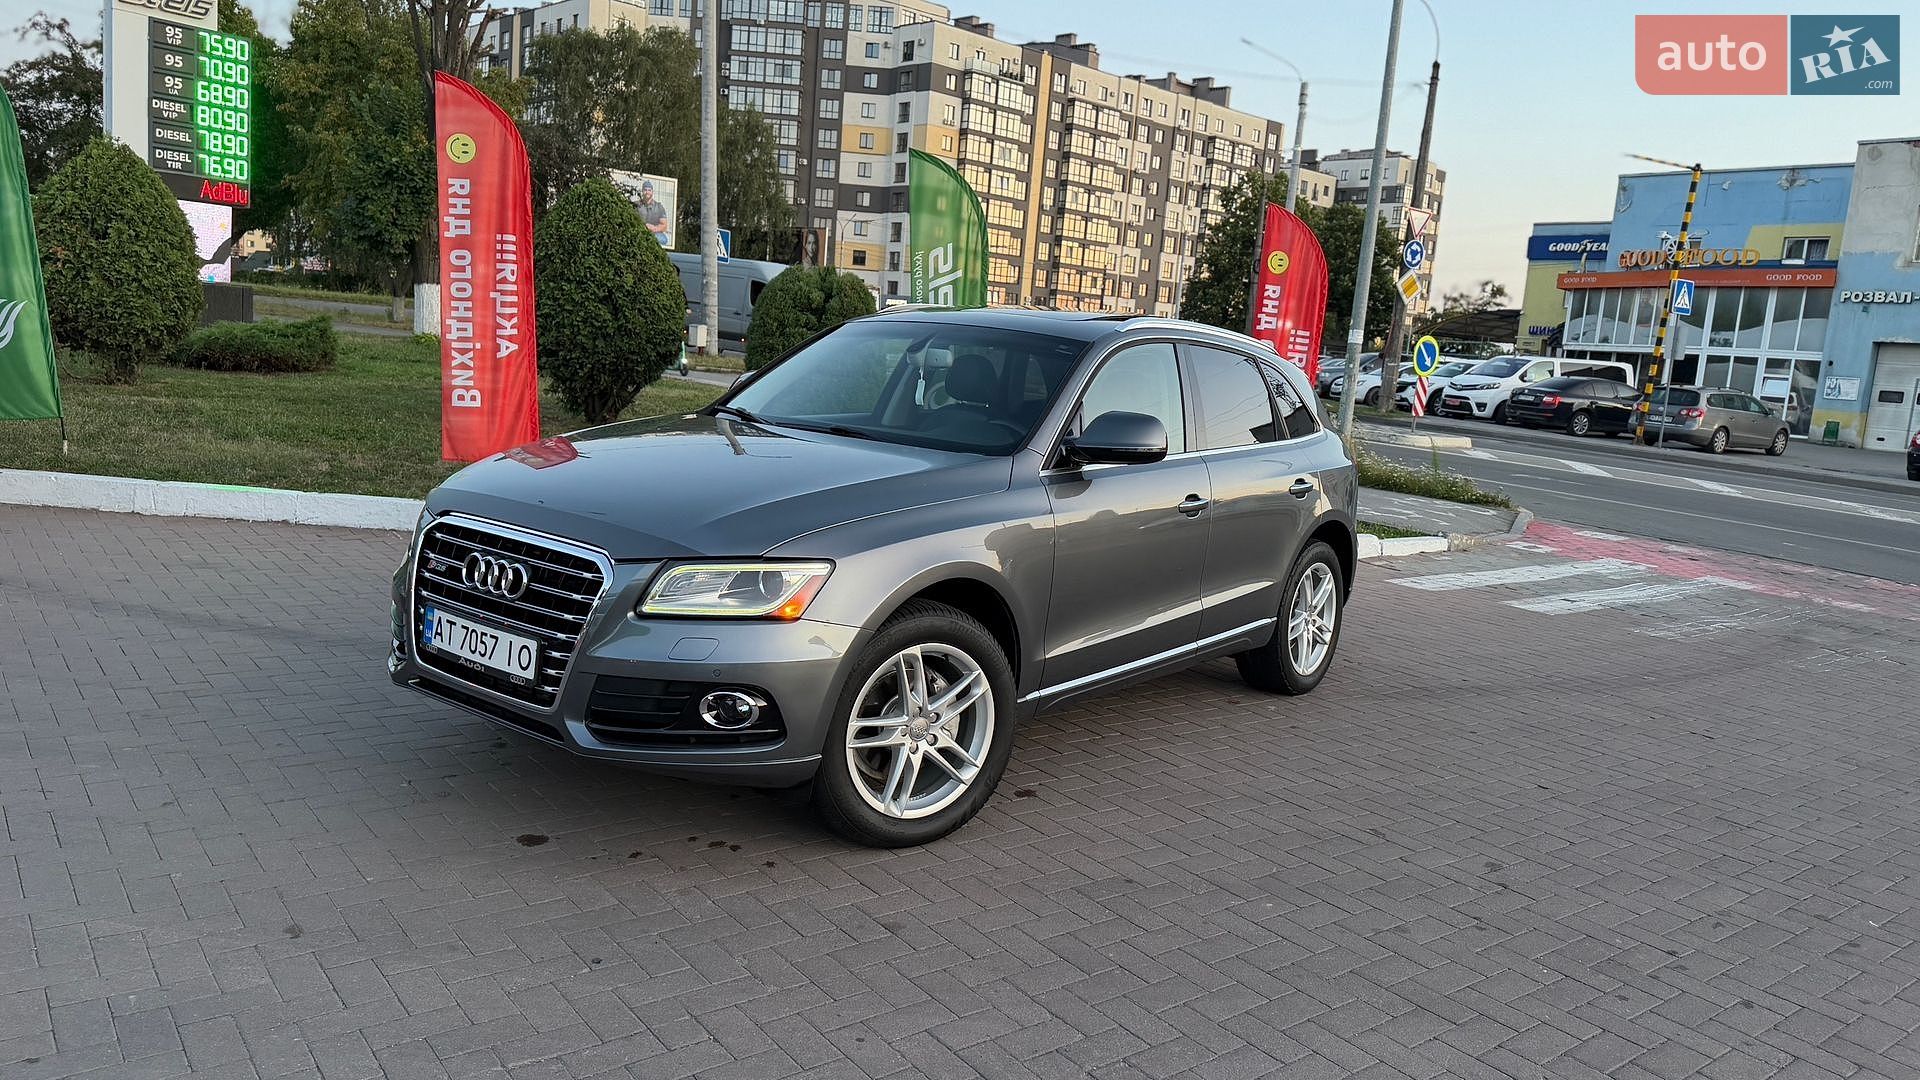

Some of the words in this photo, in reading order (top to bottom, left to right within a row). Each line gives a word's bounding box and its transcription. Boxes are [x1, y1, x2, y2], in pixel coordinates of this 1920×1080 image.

[165, 26, 183, 39] 95
[166, 37, 182, 46] VIP
[198, 32, 249, 61] 75.90
[165, 54, 183, 68] 95
[198, 57, 249, 85] 70.90
[165, 76, 183, 89] 95
[168, 88, 179, 96] UA
[197, 81, 249, 109] 68.90
[152, 99, 187, 113] DIESEL
[162, 110, 178, 119] VIP
[197, 106, 249, 133] 80.90
[155, 128, 192, 143] DIESEL
[198, 130, 249, 157] 78.90
[155, 149, 192, 163] DIESEL
[166, 160, 182, 170] TIR
[198, 154, 248, 180] 76.90
[200, 180, 248, 205] AdBlu
[1766, 273, 1792, 282] GOOD
[1796, 273, 1823, 282] FOOD
[433, 615, 457, 646] AT
[460, 624, 499, 660] 7057
